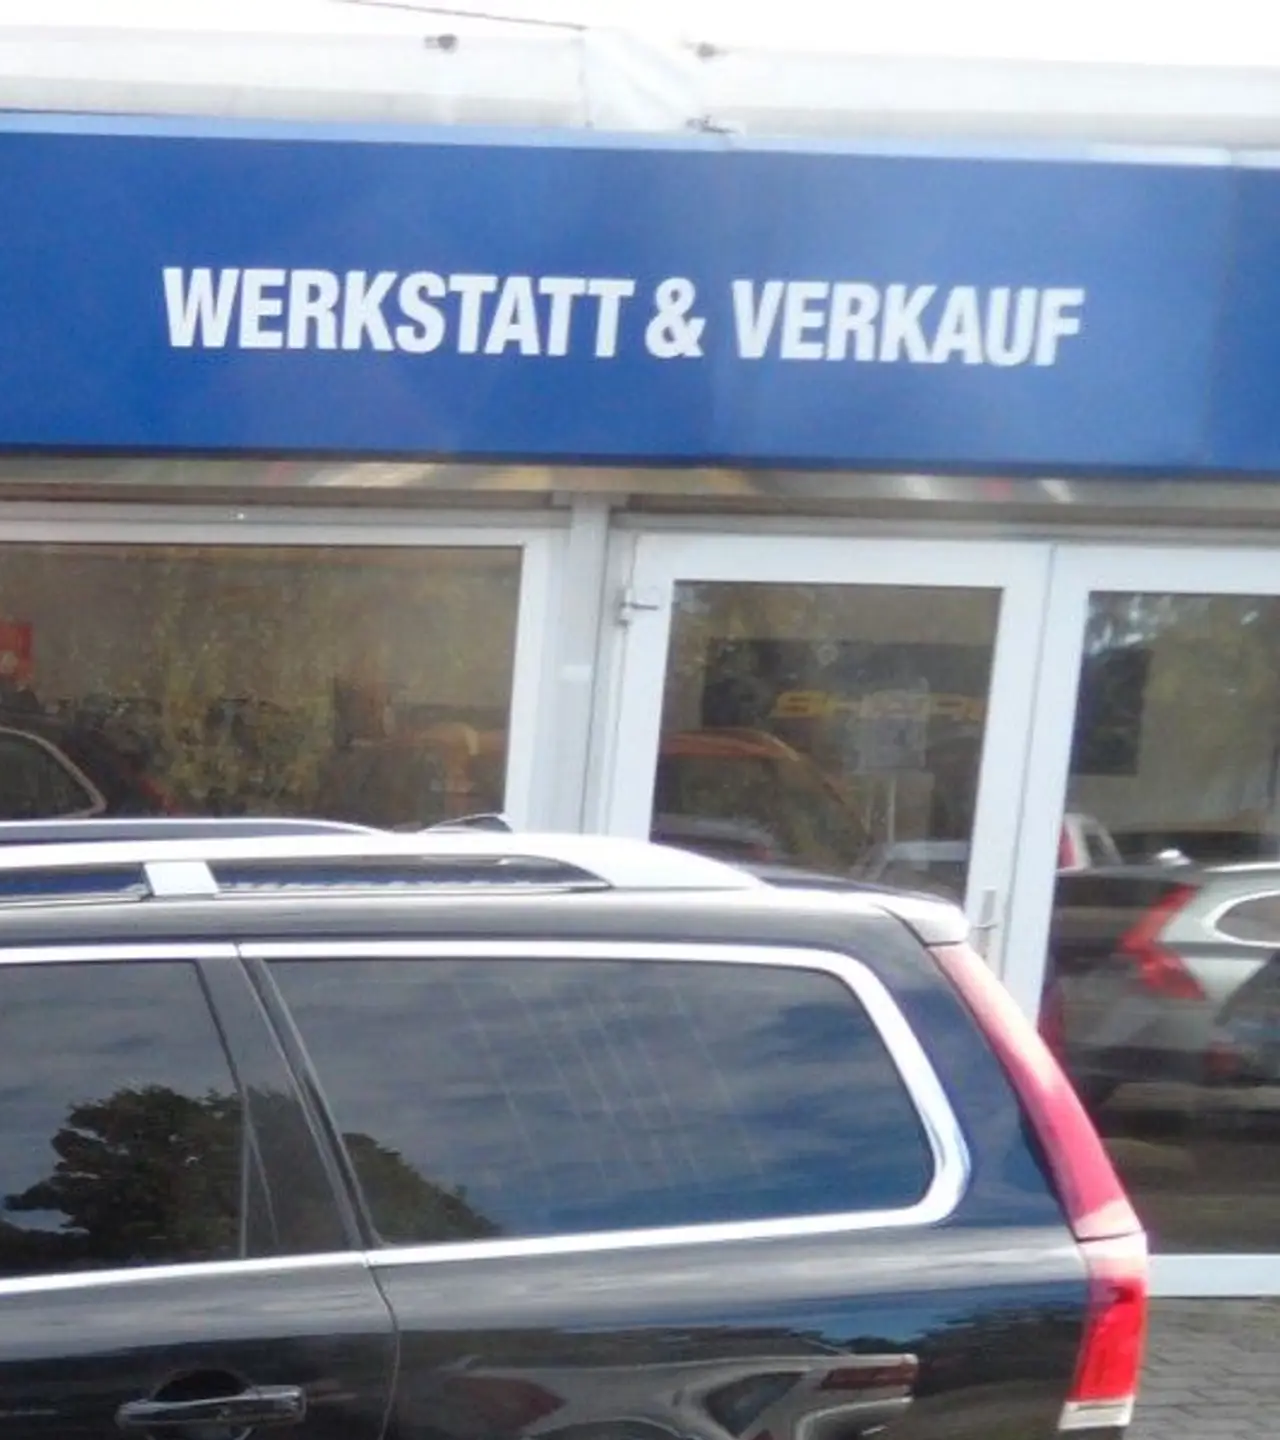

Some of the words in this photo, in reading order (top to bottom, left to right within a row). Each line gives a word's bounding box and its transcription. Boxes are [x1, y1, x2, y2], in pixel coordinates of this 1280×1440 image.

[162, 267, 636, 358] WERKSTATT
[645, 277, 706, 359] &
[731, 279, 1086, 367] VERKAUF
